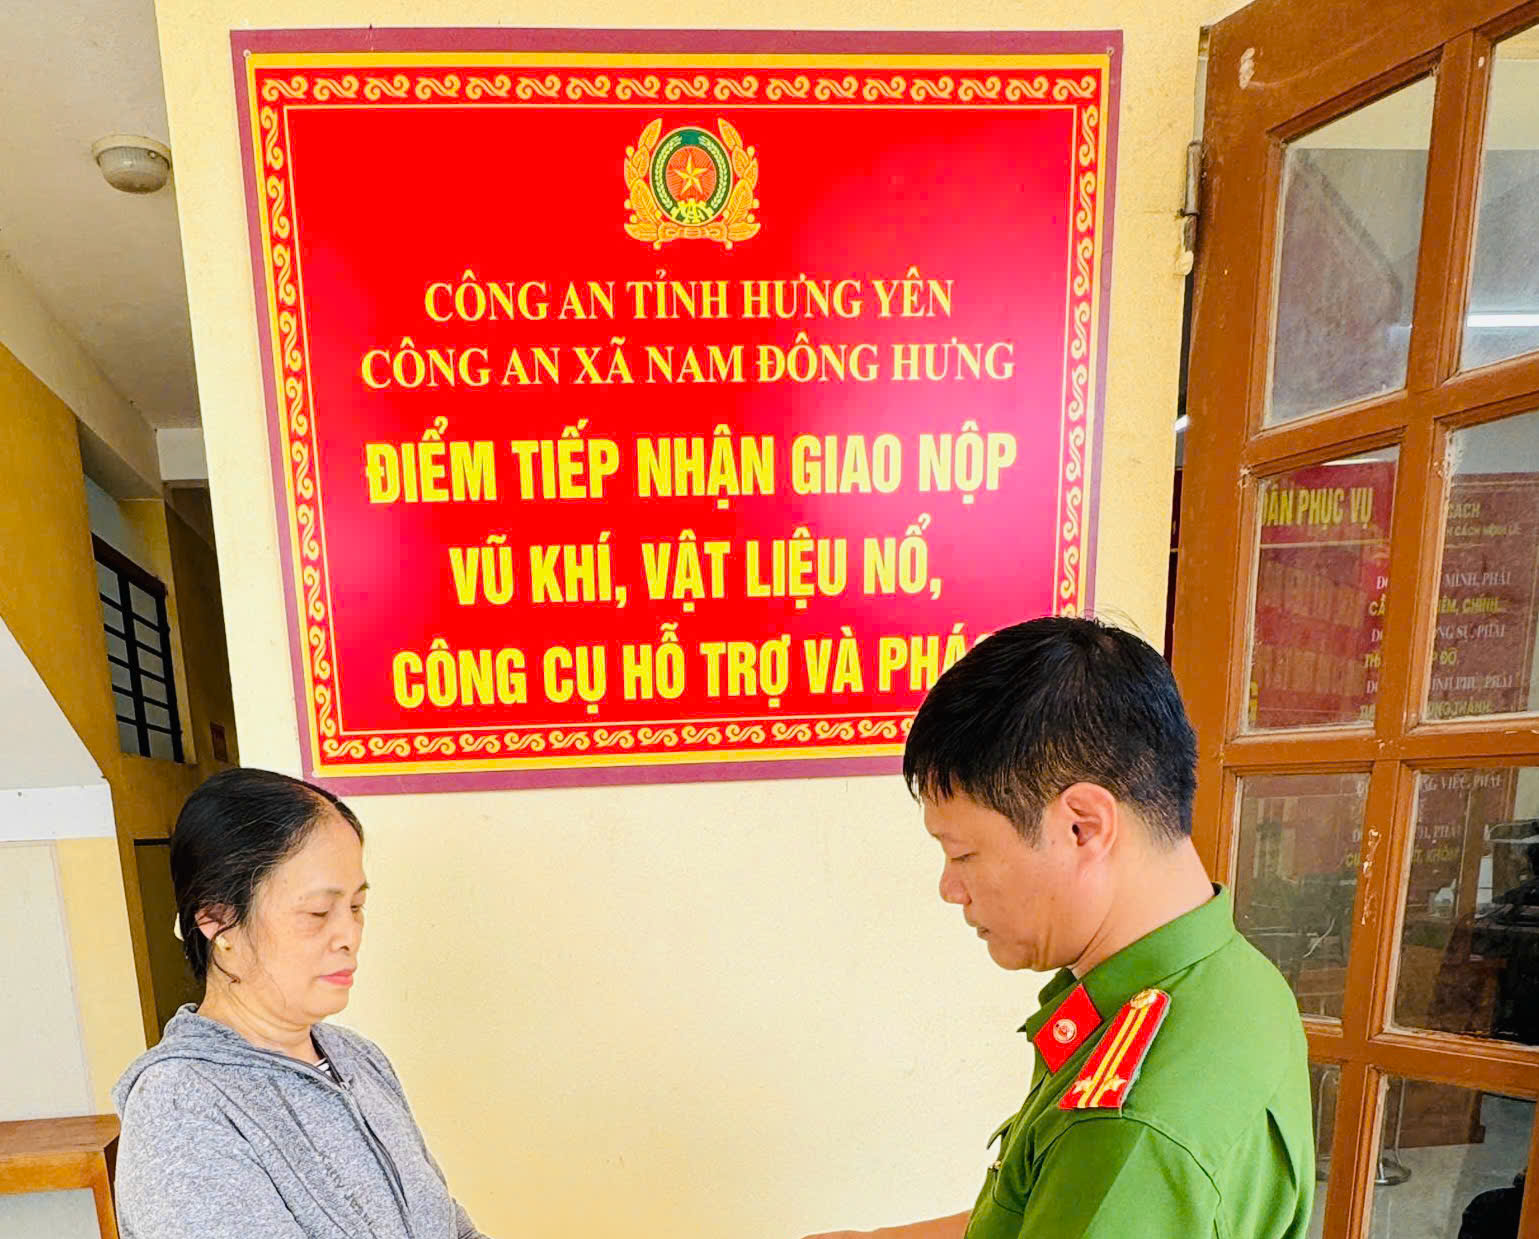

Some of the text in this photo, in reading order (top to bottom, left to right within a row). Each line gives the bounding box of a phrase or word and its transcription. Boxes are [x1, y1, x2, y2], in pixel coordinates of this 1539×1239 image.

[425, 266, 954, 322] CÔNG AN TỈNH HƯNG YÊN
[361, 331, 1015, 389] CÔNG AN XÃ NAM ĐÔNG HƯNG
[365, 415, 1018, 509] ĐIỂM TIẾP NHẬN GIAO NỘP
[1295, 487, 1344, 530] PHỤC
[1350, 486, 1373, 530] VỤ
[448, 514, 942, 610] VŨ KHÍ, VẬT LIỆU NỔ,
[392, 622, 996, 714] CÔNG CỤ HỖ TRỢ VÀ PHÁ
